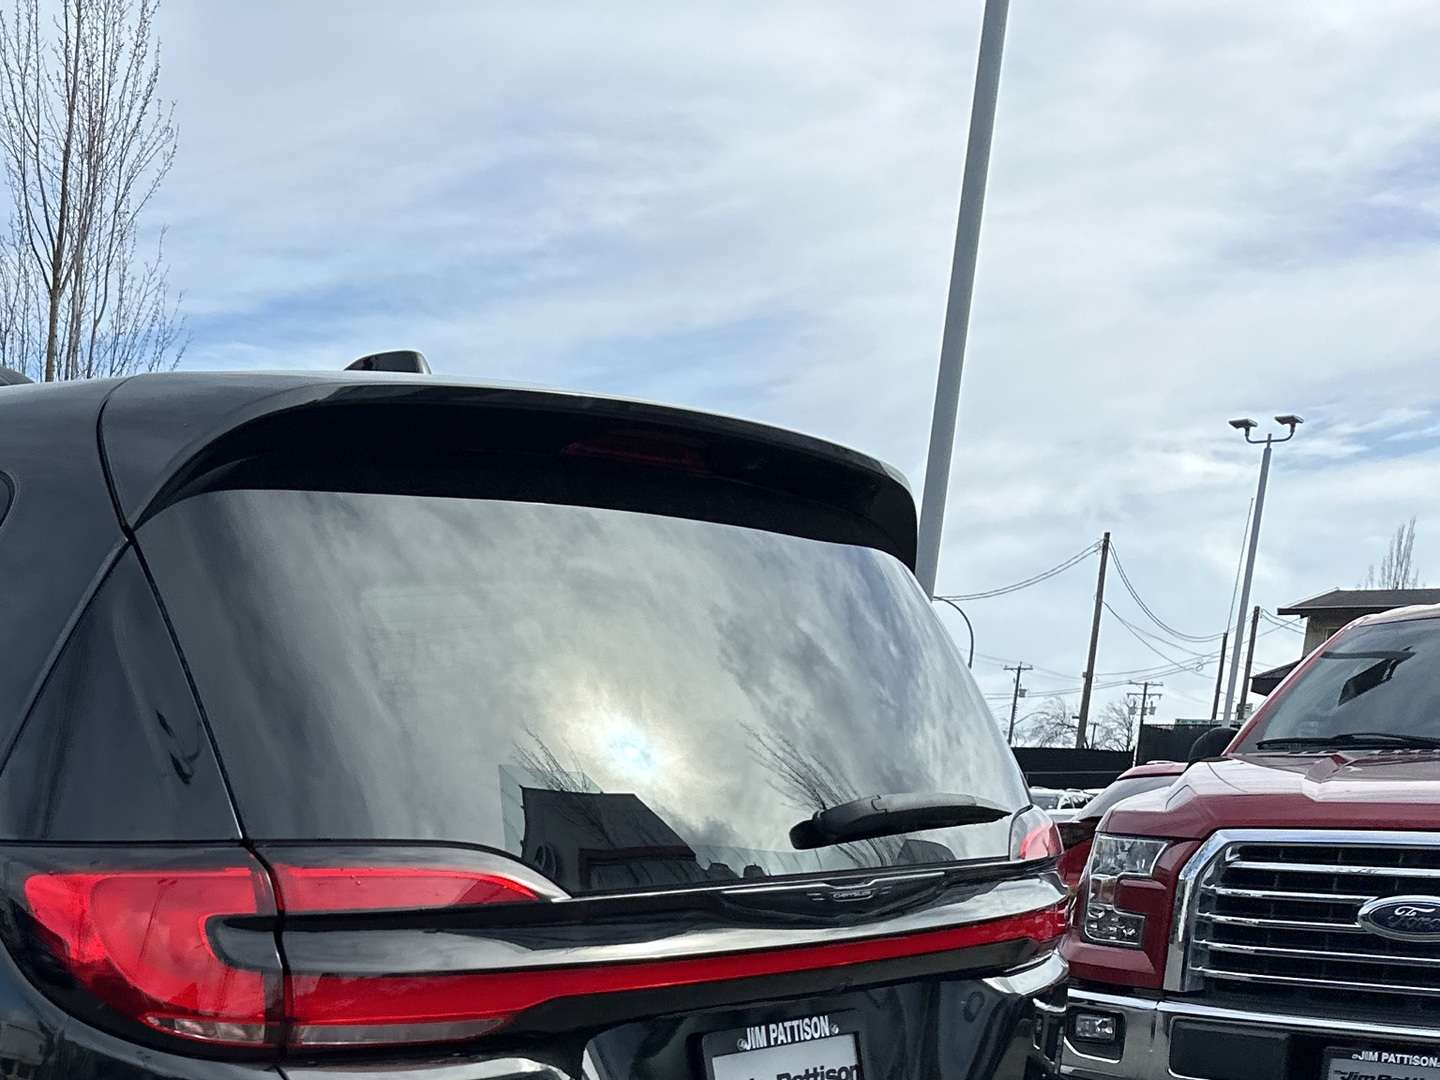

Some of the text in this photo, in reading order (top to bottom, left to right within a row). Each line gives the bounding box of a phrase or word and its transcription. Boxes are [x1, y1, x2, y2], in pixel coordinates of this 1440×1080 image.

[746, 1015, 830, 1050] JIM PATTISON
[1359, 1050, 1438, 1067] JIM PATTISON
